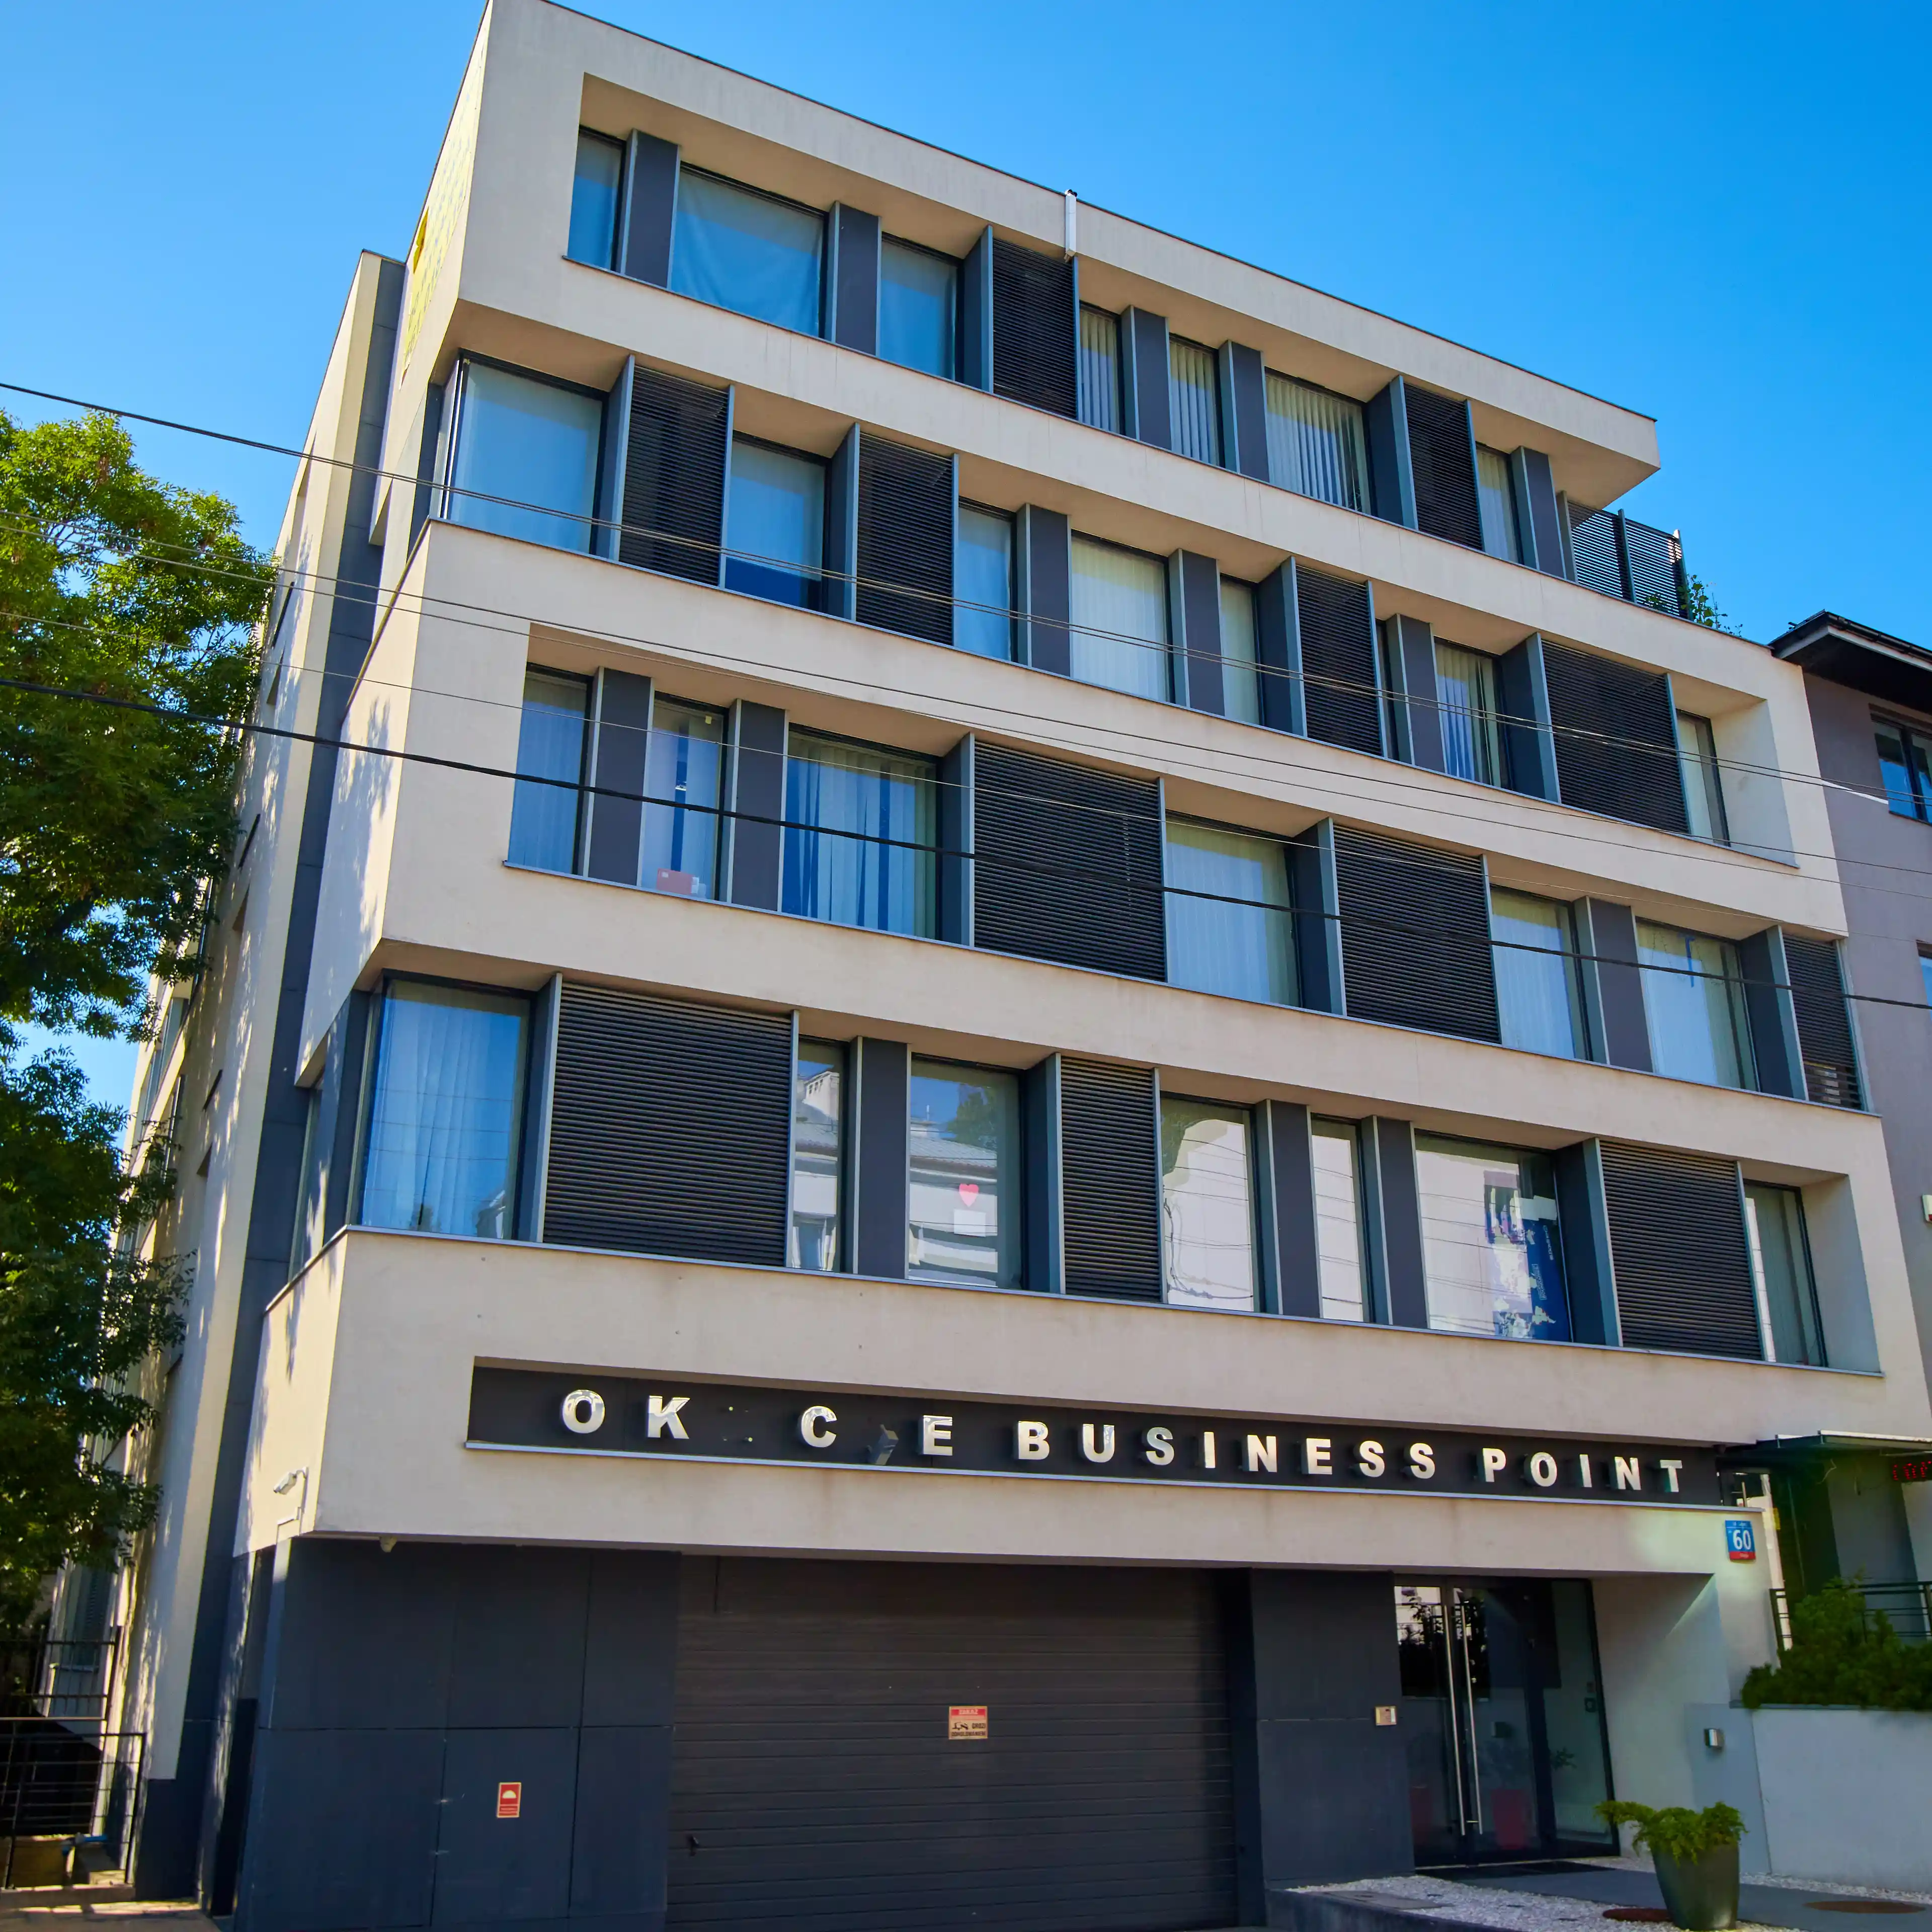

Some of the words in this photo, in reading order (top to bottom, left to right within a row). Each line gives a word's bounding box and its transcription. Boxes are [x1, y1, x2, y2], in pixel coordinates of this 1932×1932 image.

[1014, 1420, 1435, 1479] BUSINESS
[1482, 1447, 1683, 1493] POINT
[1733, 1529, 1752, 1550] 60
